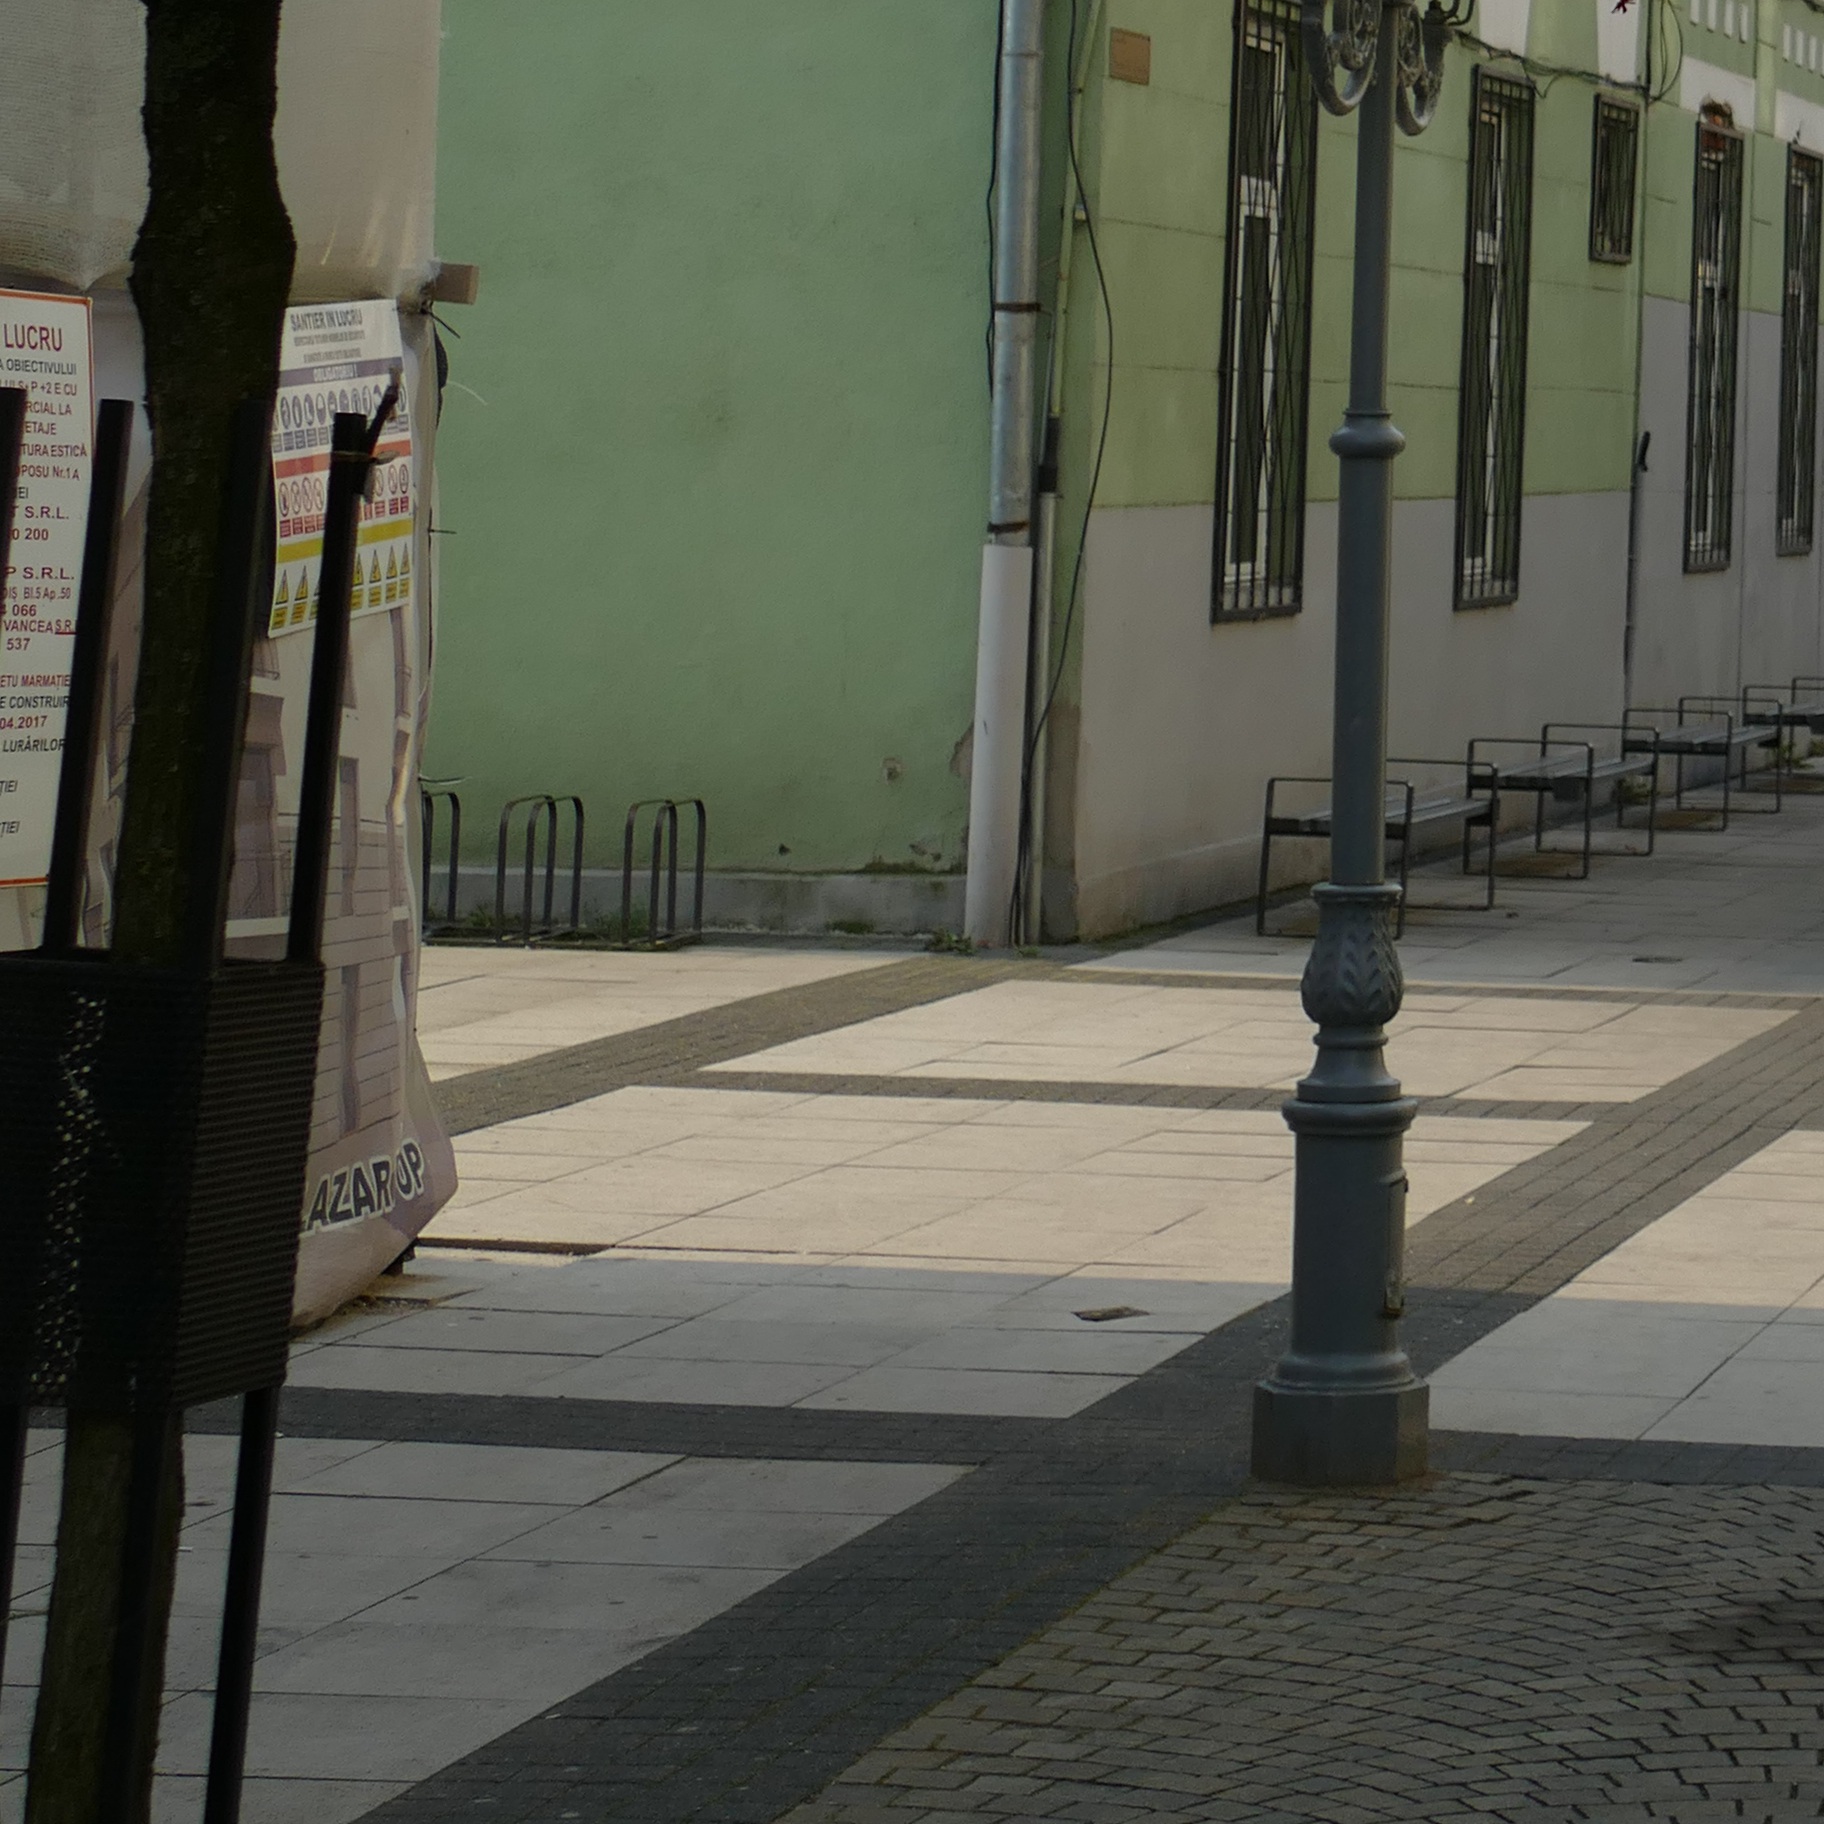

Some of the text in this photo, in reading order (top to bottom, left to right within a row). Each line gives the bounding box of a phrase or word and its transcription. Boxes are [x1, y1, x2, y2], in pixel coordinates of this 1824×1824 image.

[4, 323, 62, 352] LUCRU
[7, 358, 77, 376] OBIECTIVULUI
[64, 384, 77, 397] CU
[58, 403, 72, 416] LA
[24, 506, 69, 520] S.R.L.
[24, 528, 49, 541] 200
[23, 567, 75, 580] S.R.L.
[12, 604, 37, 617] 066
[6, 638, 31, 651] 537
[303, 1158, 394, 1234] AZAR
